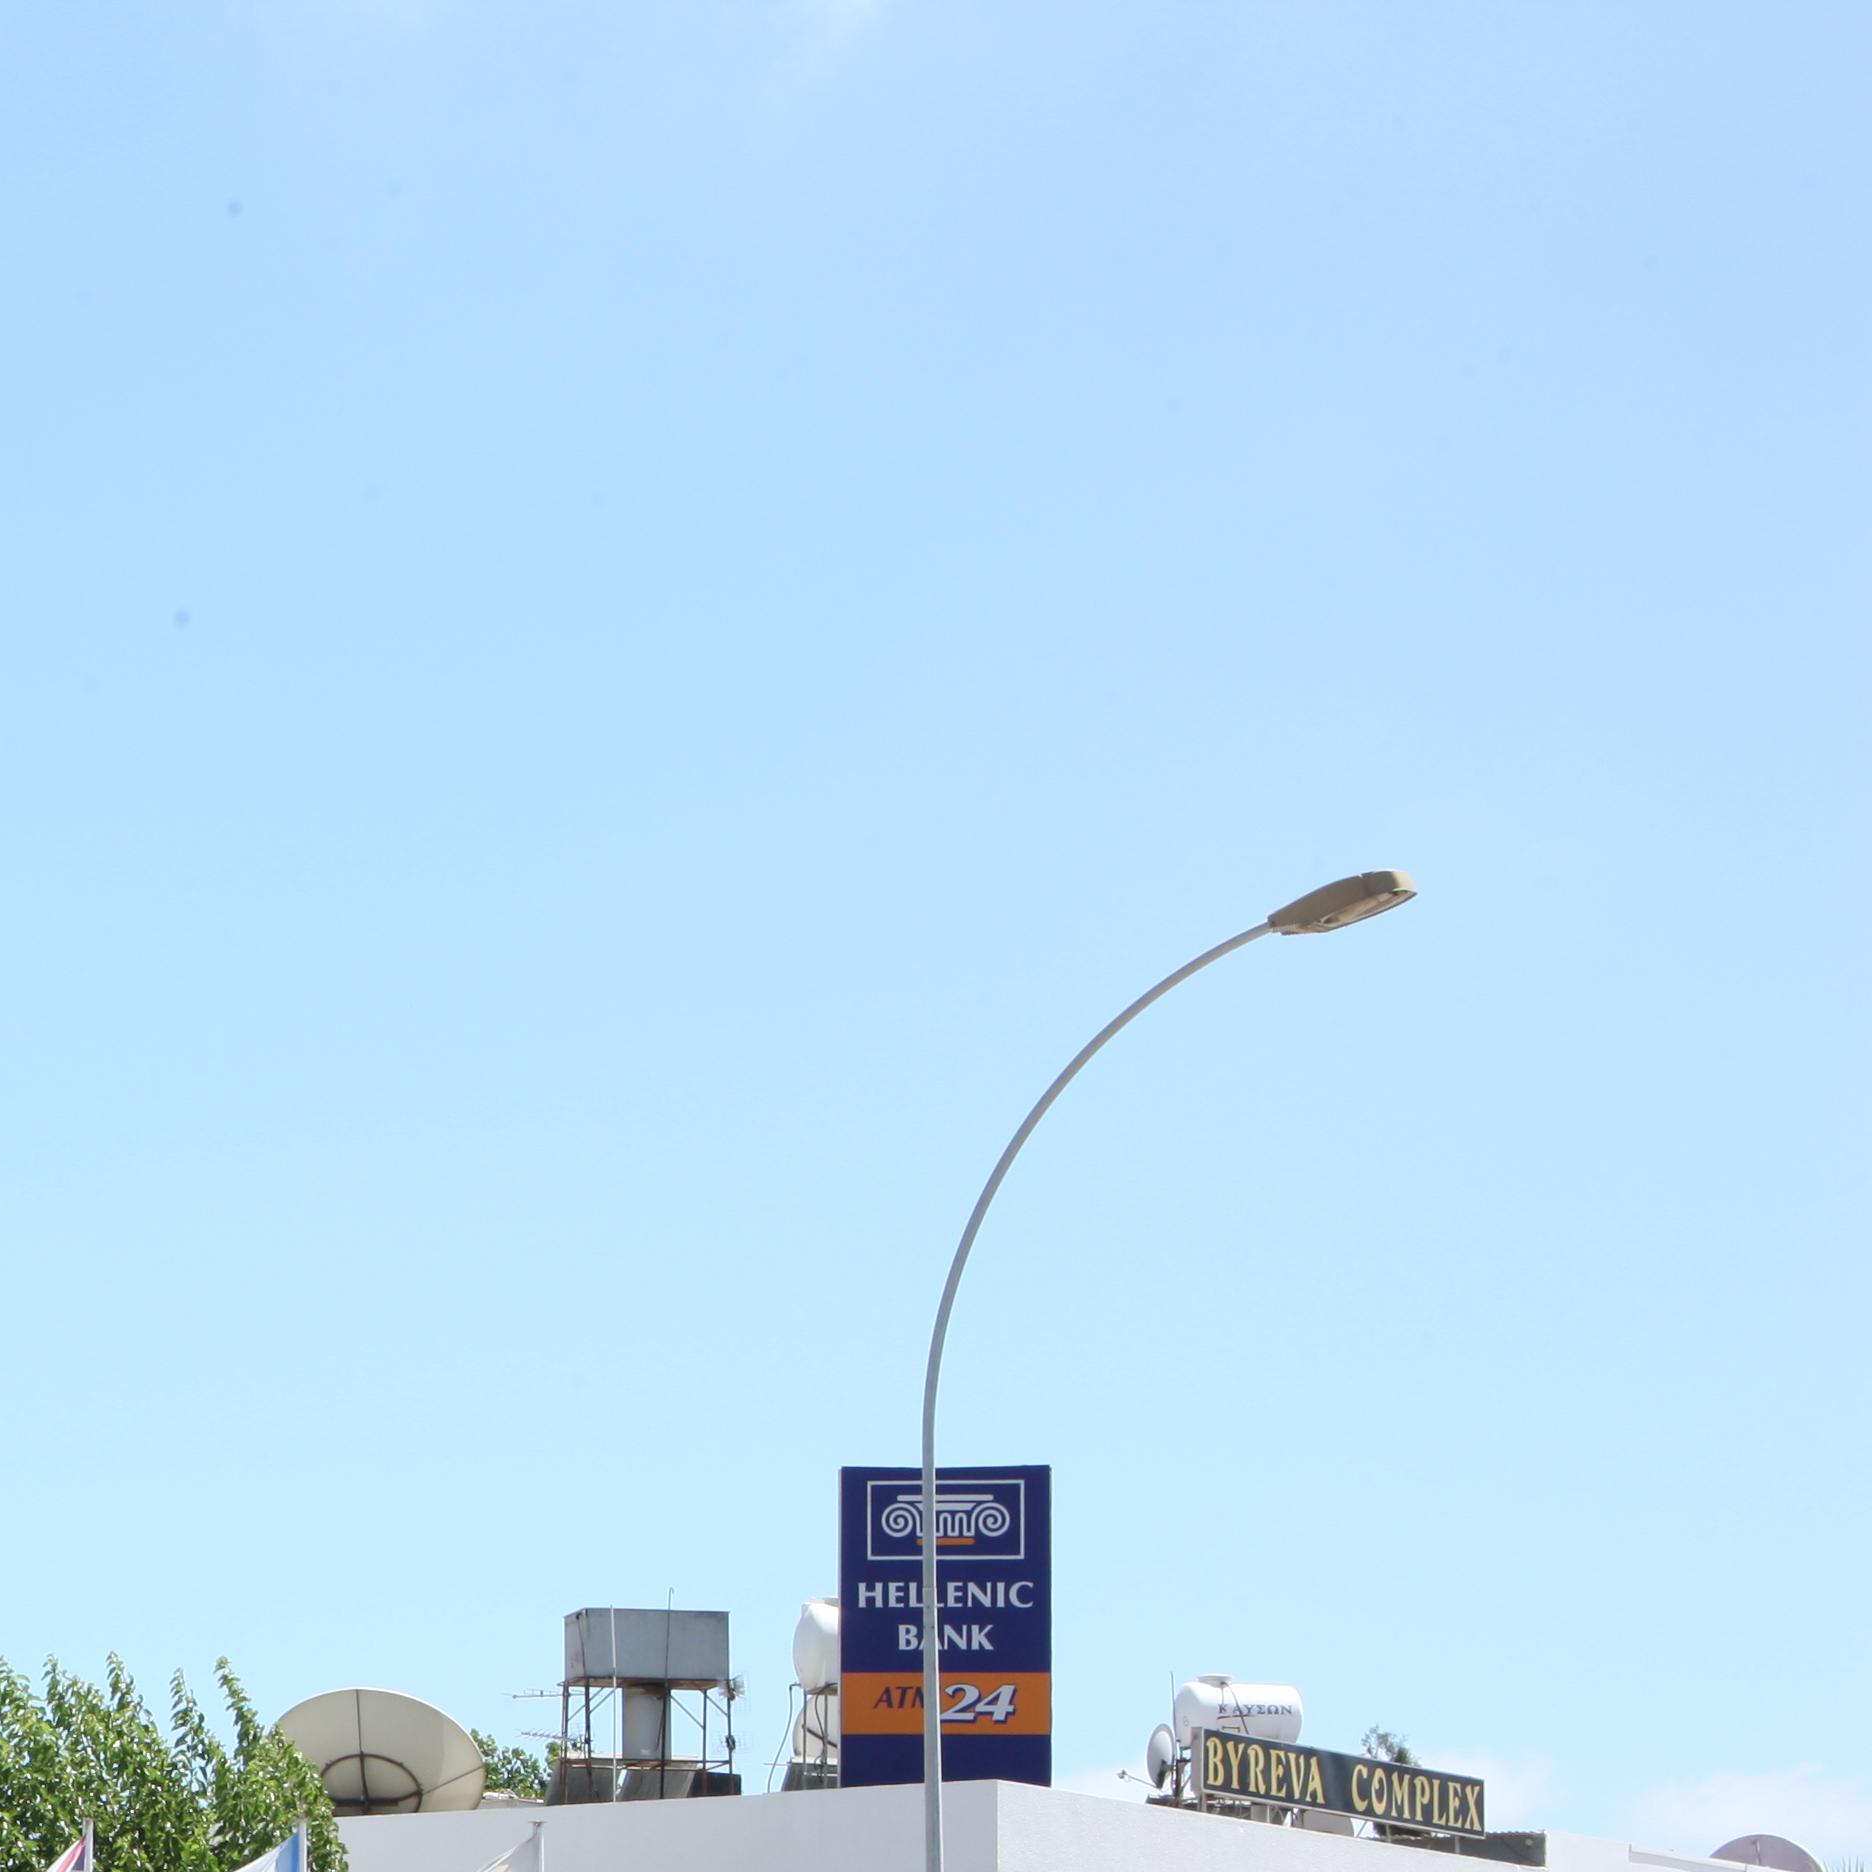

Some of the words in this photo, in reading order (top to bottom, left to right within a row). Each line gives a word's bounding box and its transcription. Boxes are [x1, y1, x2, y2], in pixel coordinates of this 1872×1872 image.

[940, 1684, 1017, 1724] 24
[1206, 1736, 1325, 1804] BYREVA
[1351, 1763, 1482, 1832] COMPLEX
